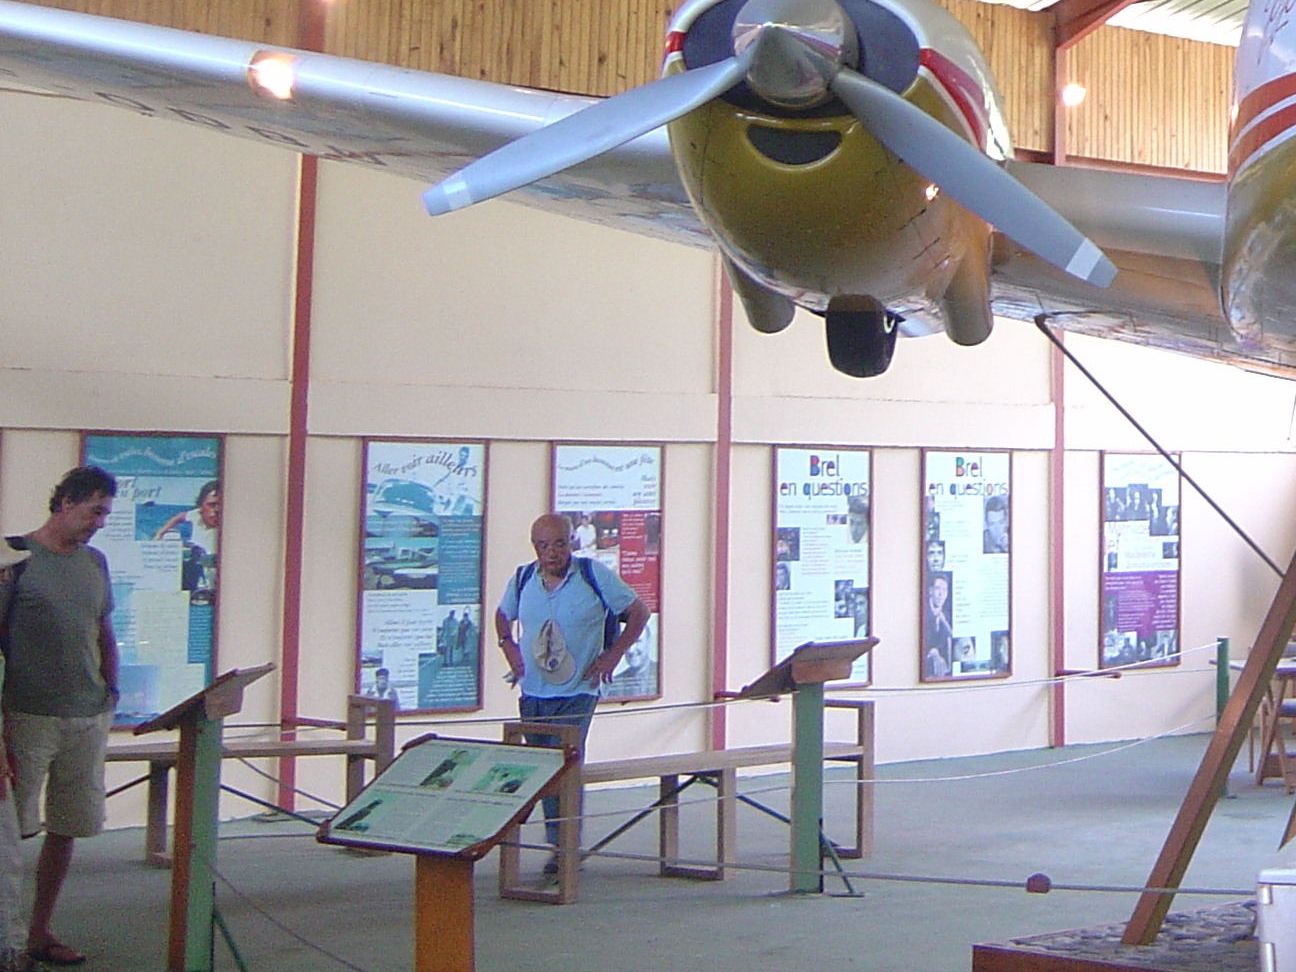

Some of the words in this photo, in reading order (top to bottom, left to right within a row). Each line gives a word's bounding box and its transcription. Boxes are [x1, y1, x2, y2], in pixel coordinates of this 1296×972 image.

[373, 463, 399, 475] Aller
[402, 454, 422, 473] voir
[809, 454, 840, 477] Brel
[955, 456, 983, 477] Brel
[780, 482, 797, 496] en
[803, 477, 868, 500] questions
[928, 483, 944, 496] en
[949, 478, 1008, 500] questions
